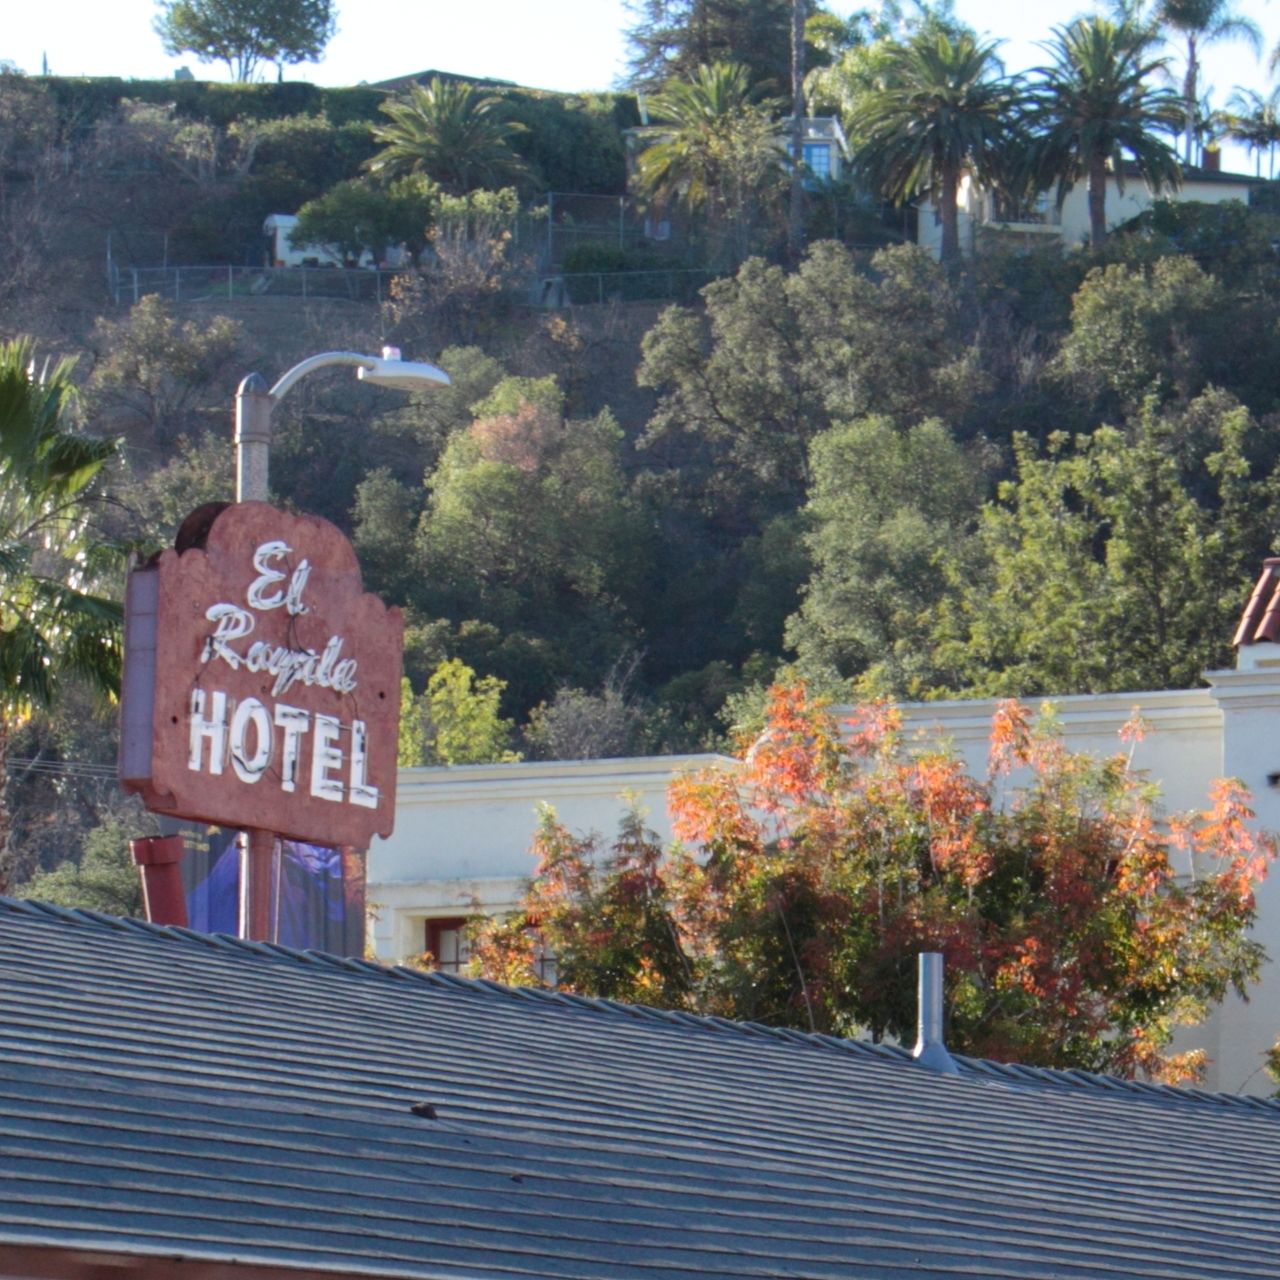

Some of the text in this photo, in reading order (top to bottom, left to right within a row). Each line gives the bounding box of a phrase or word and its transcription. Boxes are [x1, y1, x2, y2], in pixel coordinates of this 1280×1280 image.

[247, 541, 312, 616] El
[200, 603, 358, 697] Royale
[187, 688, 382, 810] HOTEL
